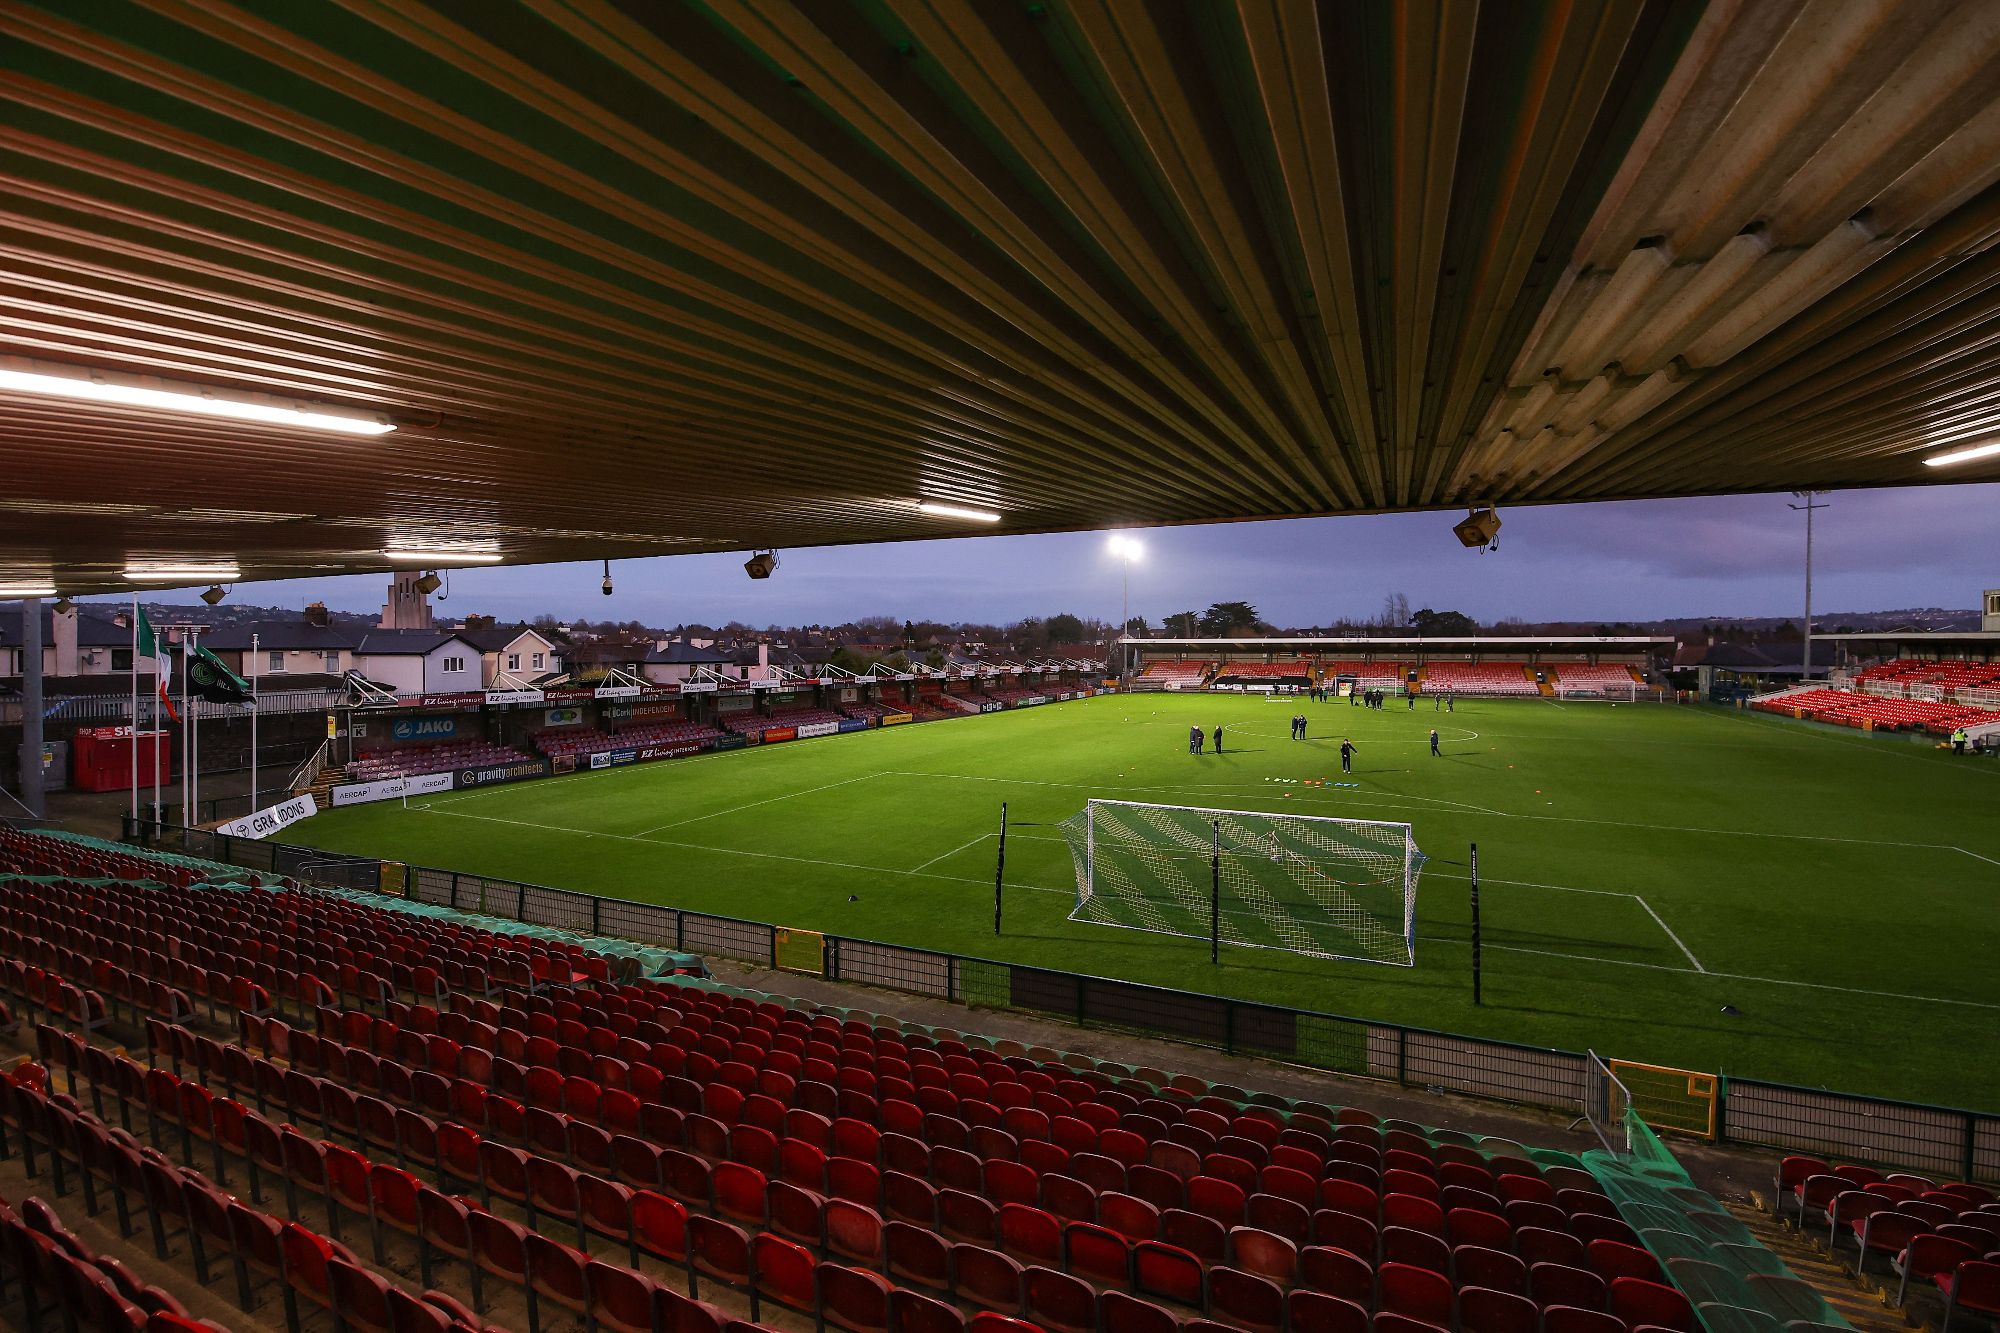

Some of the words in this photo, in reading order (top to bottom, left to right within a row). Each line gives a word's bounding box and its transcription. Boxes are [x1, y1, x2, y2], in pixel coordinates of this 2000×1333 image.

[437, 697, 458, 707] living
[501, 694, 518, 704] living
[632, 704, 676, 716] INDEPENDENT
[79, 728, 92, 736] SHOP
[416, 720, 454, 734] JAKO
[641, 750, 653, 758] EZ
[654, 747, 673, 757] living
[673, 746, 699, 754] INTERIORS
[477, 763, 543, 782] gravityarchitects
[340, 790, 367, 799] AERCAP
[421, 780, 446, 788] AERCAP
